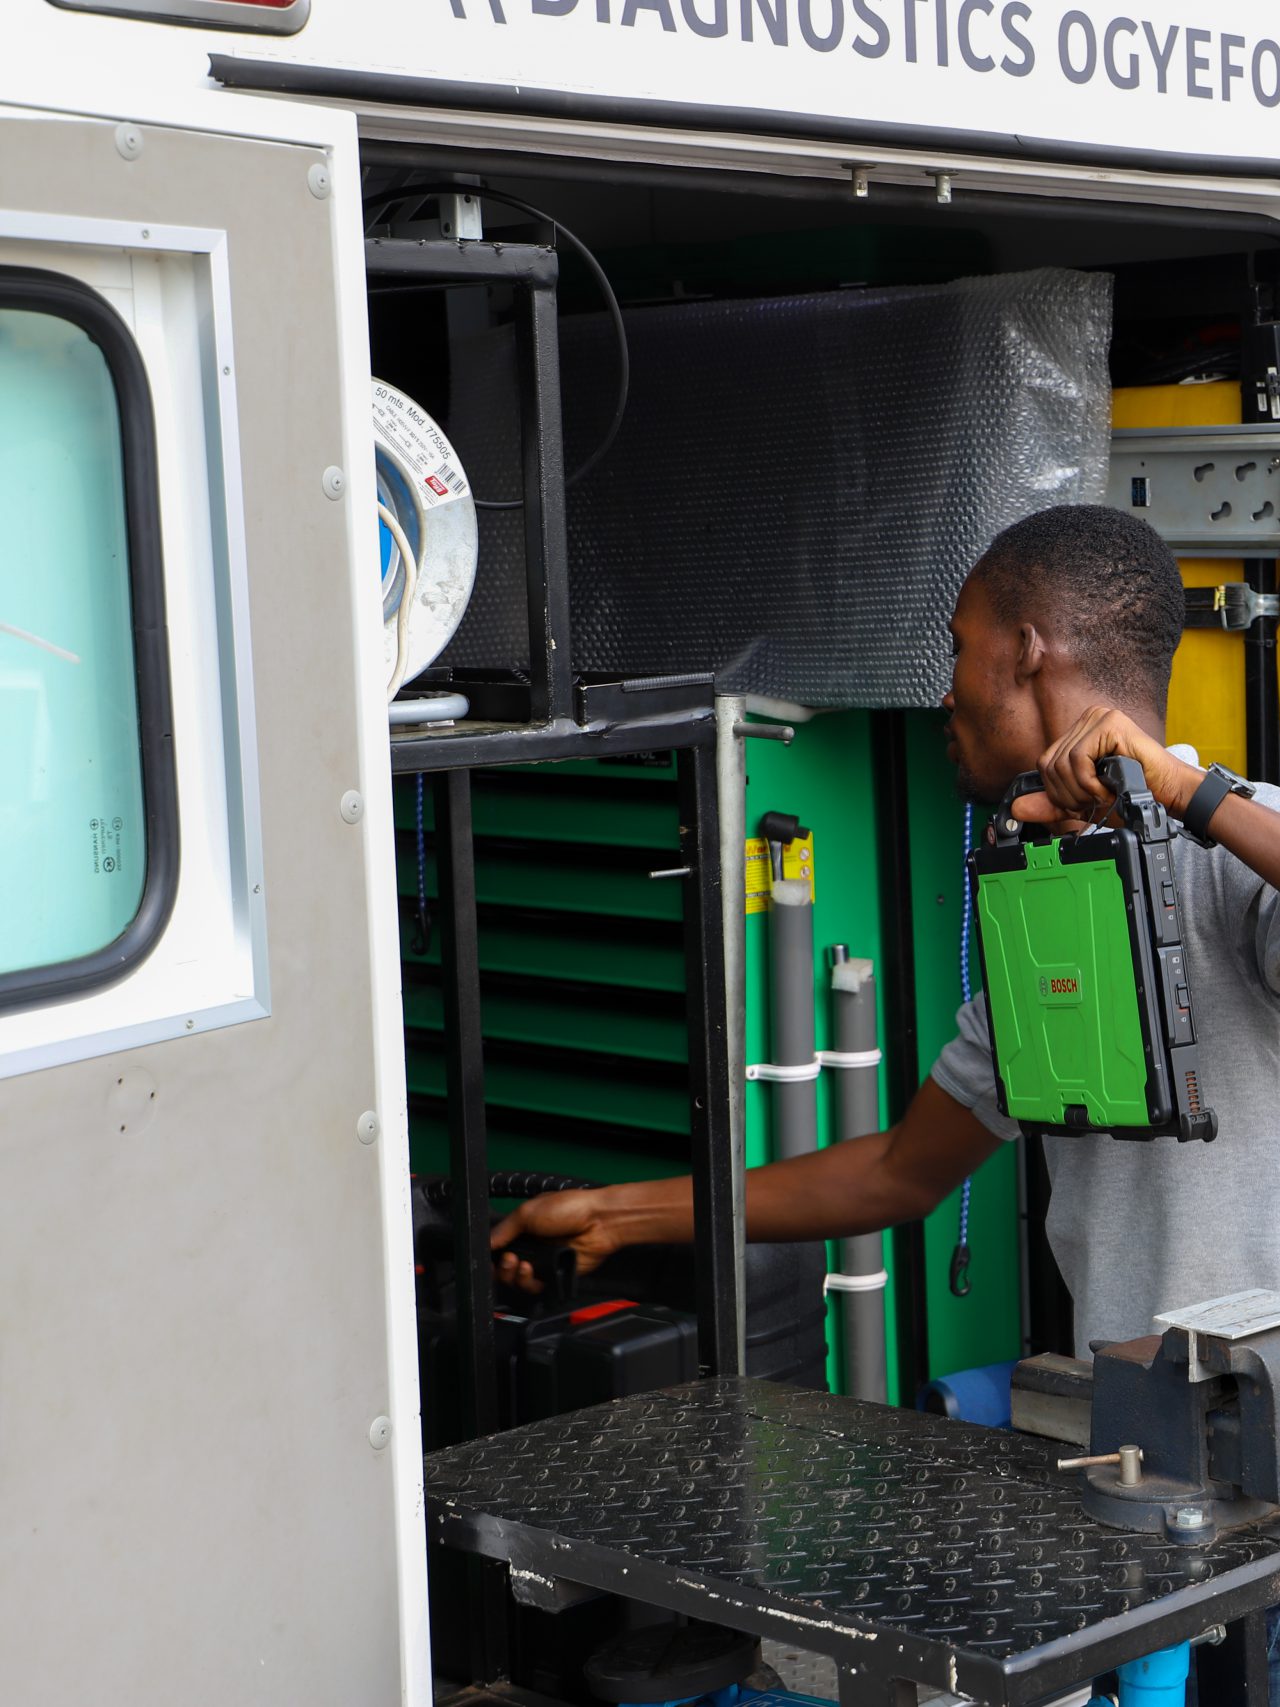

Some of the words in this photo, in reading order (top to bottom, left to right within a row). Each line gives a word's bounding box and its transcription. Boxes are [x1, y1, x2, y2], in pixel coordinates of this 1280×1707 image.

[531, 0, 1035, 78] NOSTICS
[375, 387, 388, 399] 50
[388, 394, 404, 411] mts.
[425, 426, 452, 460] 775505
[1051, 978, 1078, 993] BOSCH
